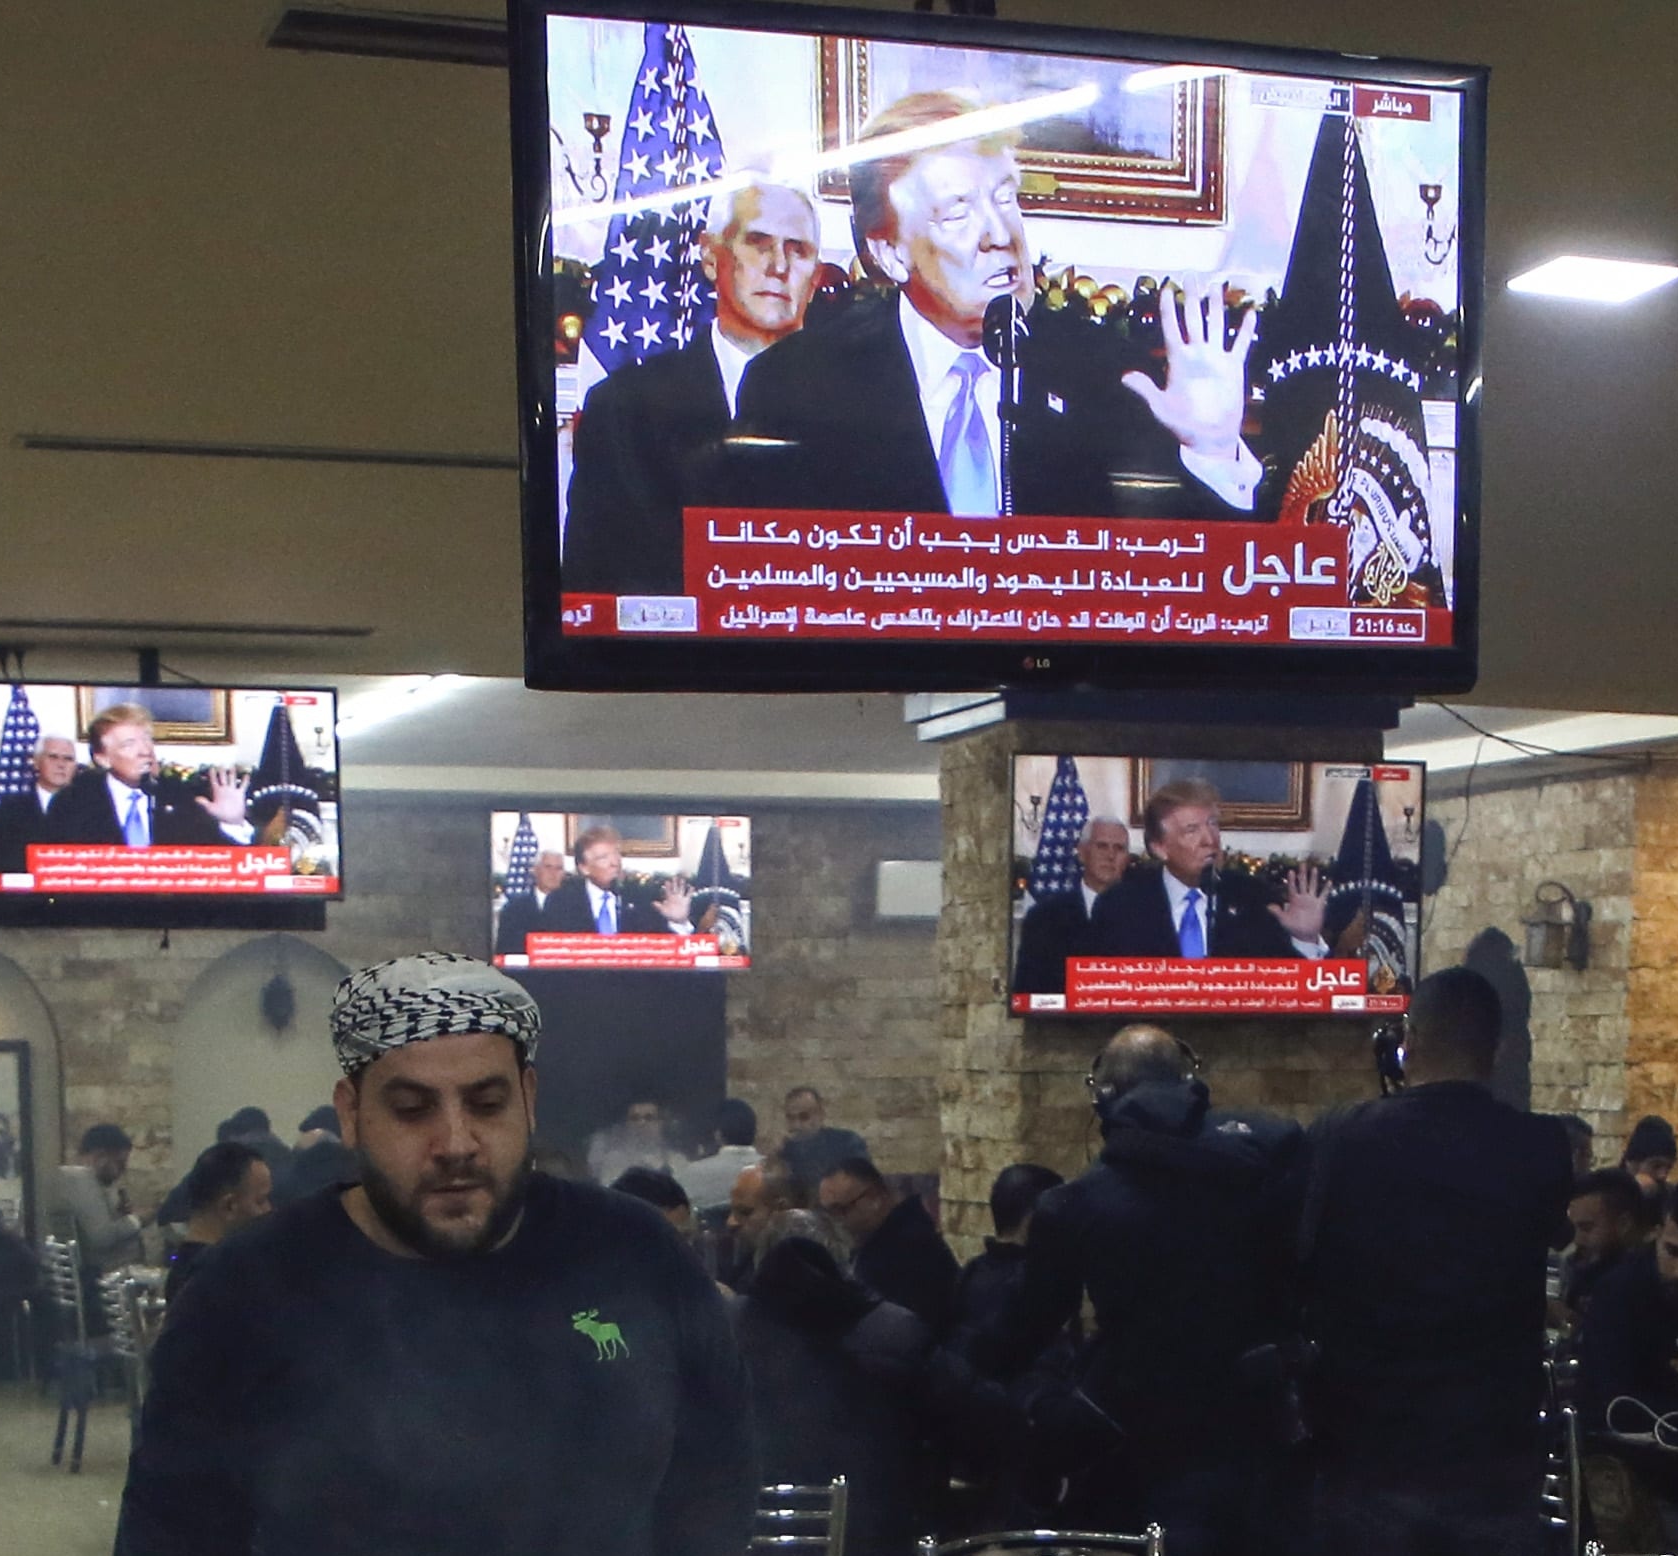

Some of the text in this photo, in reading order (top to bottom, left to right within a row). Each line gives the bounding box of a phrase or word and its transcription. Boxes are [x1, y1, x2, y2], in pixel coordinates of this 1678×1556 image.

[1371, 93, 1413, 117] مباشر
[707, 516, 1205, 558] ترمب: القدس يجب أن تكون مكانا
[707, 563, 1205, 596] للعبادة لليهود والمسيحيين والمسلمين
[1223, 540, 1337, 597] عاجل
[1355, 617, 1394, 634] 21:16
[1036, 658, 1050, 668] LG
[237, 853, 287, 874] عاجل
[677, 939, 715, 955] عاجل
[1305, 966, 1361, 991] عاجل
